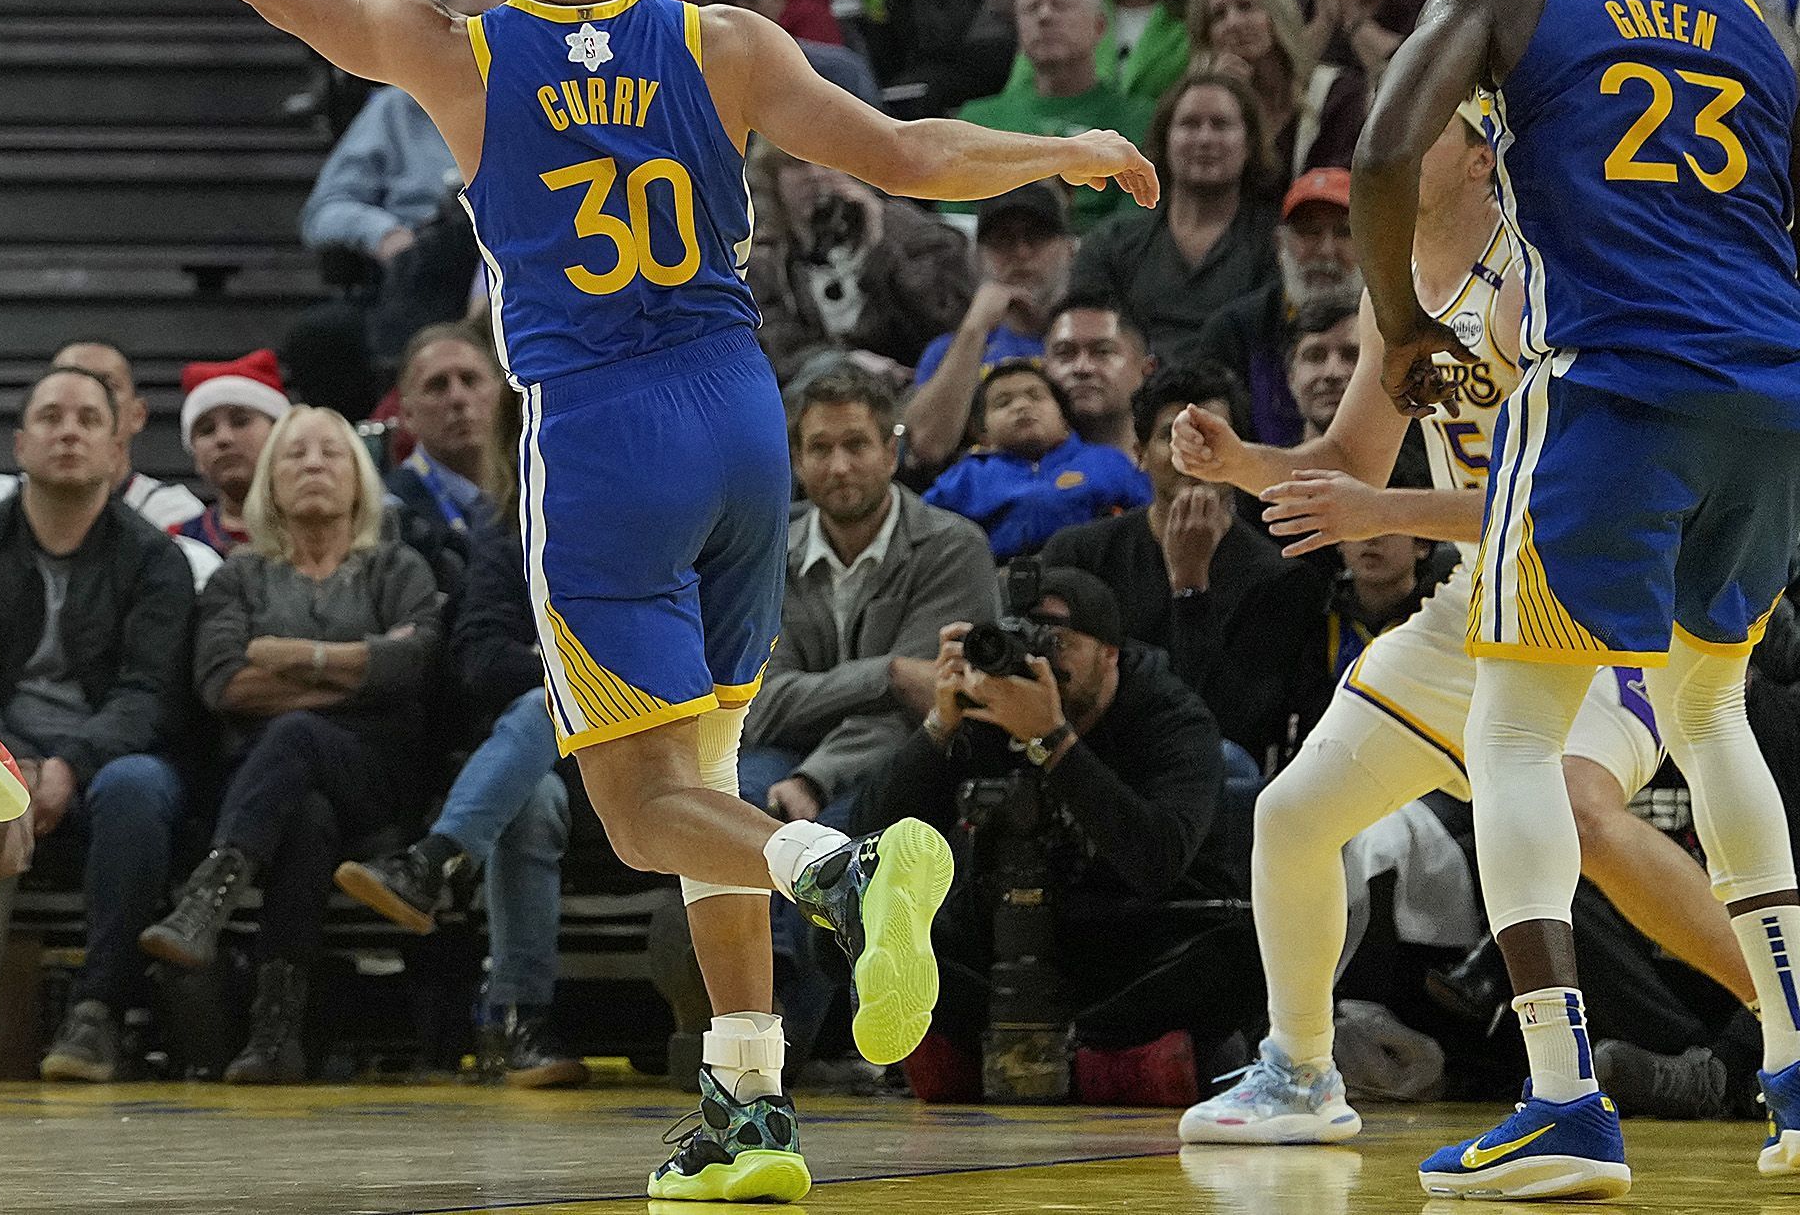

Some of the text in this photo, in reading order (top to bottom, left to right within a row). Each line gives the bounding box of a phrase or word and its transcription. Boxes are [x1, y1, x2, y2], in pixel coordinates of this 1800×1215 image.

[1604, 0, 1718, 51] GREEN
[537, 76, 660, 131] CURRY
[1600, 61, 1748, 194] 23
[539, 157, 701, 295] 30
[1453, 320, 1481, 336] bibigo
